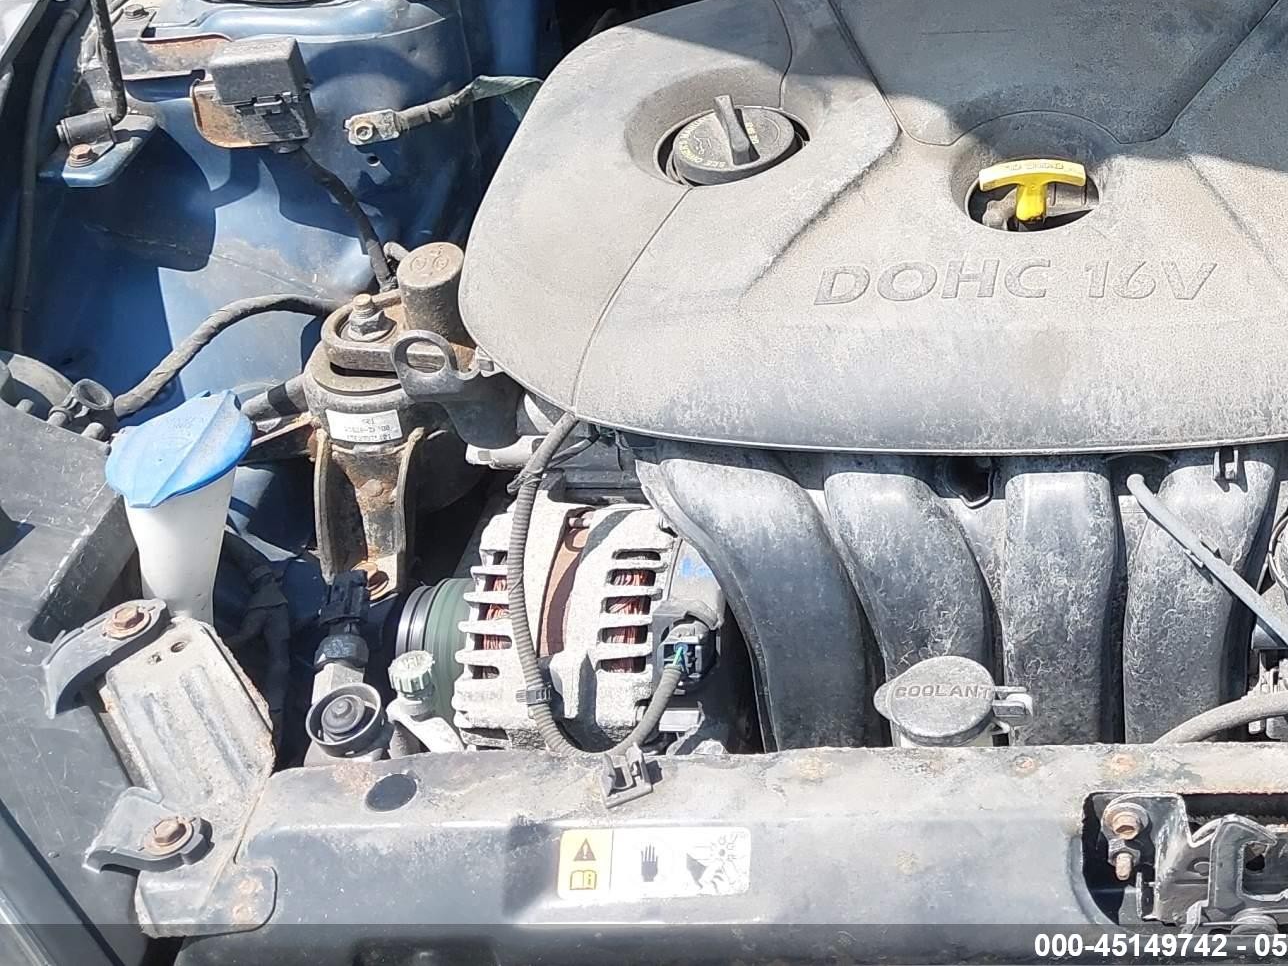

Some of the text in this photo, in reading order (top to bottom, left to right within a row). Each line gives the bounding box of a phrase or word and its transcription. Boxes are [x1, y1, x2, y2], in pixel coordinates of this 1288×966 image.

[814, 259, 1218, 306] DOHC 16V
[895, 684, 992, 700] COOLANT
